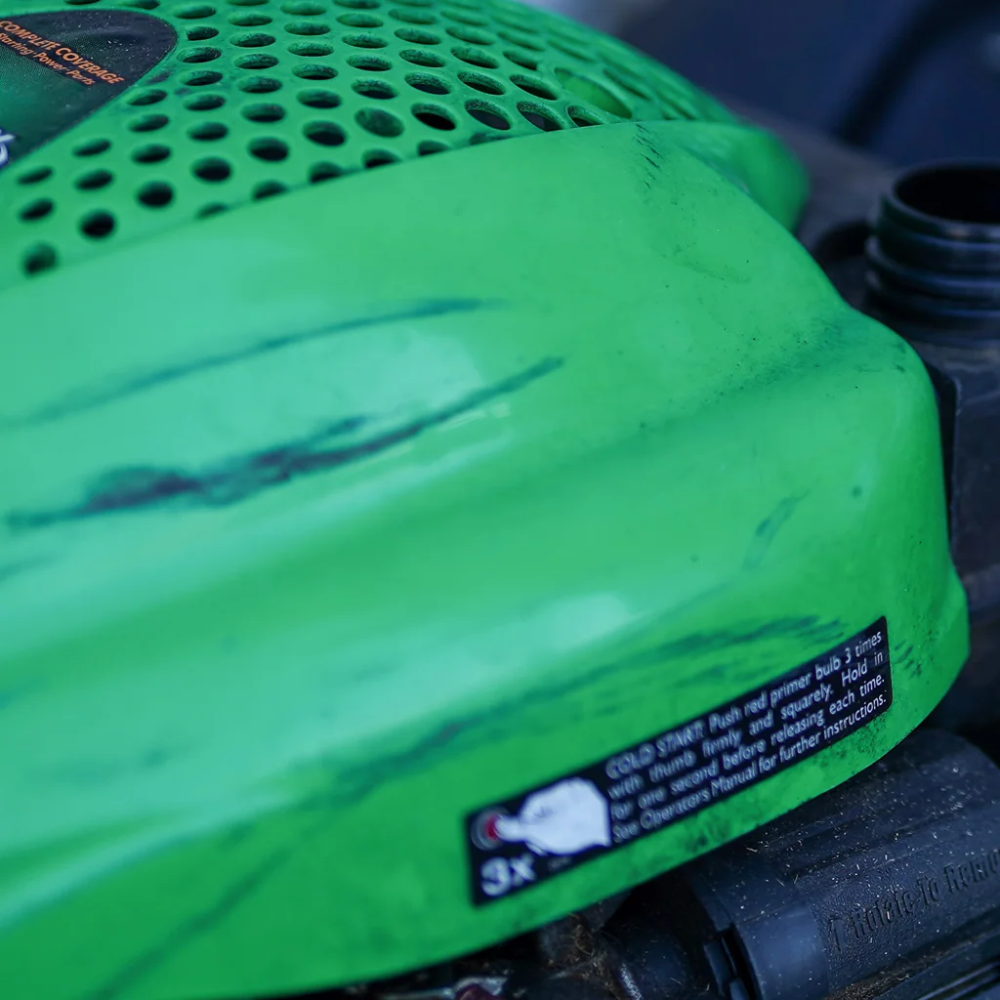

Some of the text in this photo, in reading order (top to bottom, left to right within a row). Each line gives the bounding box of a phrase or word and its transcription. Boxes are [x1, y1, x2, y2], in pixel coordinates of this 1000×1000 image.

[0, 20, 125, 84] COMPLETE COVERAGE
[66, 69, 96, 86] Parts
[605, 743, 655, 779] COLD
[708, 706, 742, 733] Push
[743, 691, 767, 716] red
[769, 672, 812, 708] primer
[814, 655, 841, 680] bulb
[844, 646, 851, 664] 3
[854, 630, 882, 657] times
[607, 651, 883, 799] with thumb firmly and squarely. Hold in
[609, 673, 885, 820] for one second before releasing each time.
[611, 821, 639, 843] See
[710, 761, 757, 796] Manual
[757, 754, 777, 773] for
[778, 731, 821, 762] further
[821, 693, 886, 739] instructions.
